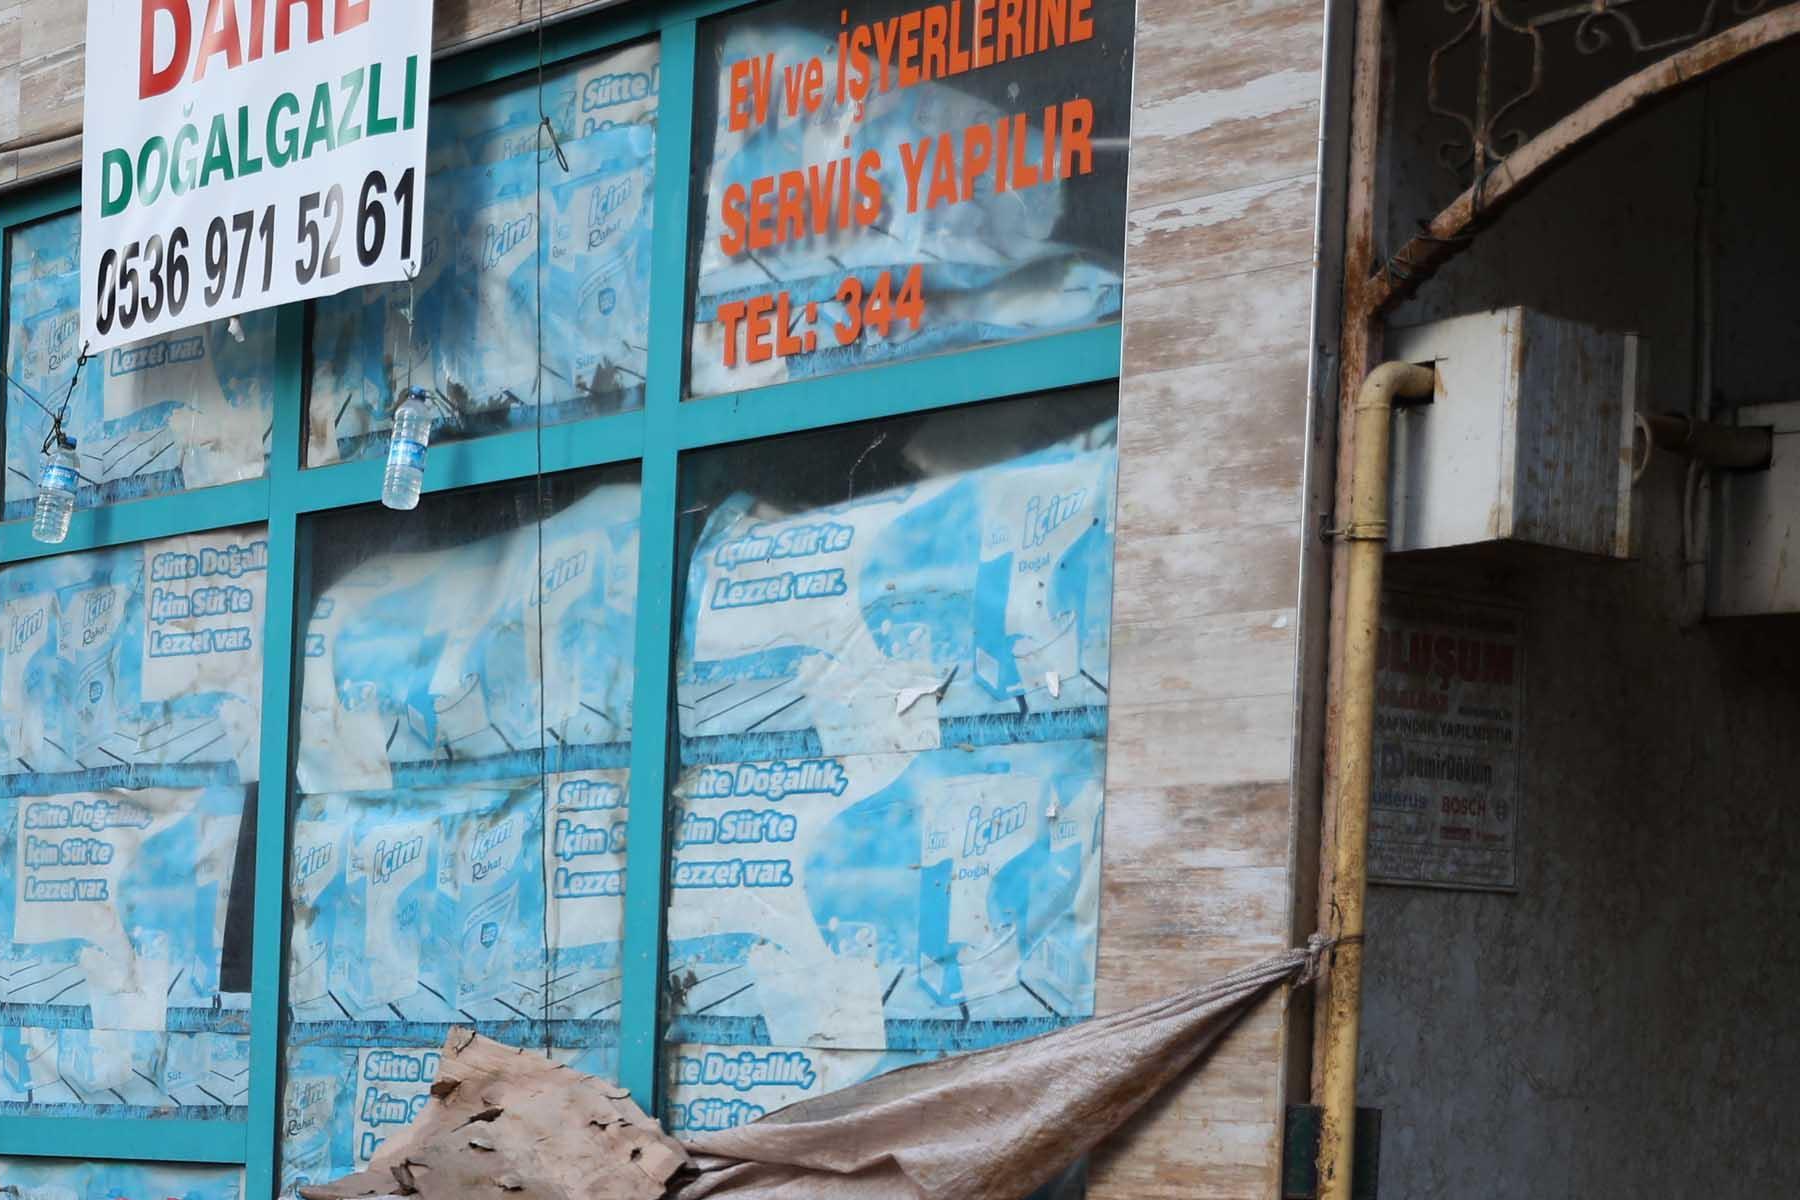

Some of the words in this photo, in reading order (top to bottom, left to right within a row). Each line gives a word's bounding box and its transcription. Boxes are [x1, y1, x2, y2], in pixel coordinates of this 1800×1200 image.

[100, 54, 417, 218] DOĞALGAZLI
[727, 53, 775, 132] EV
[784, 64, 824, 114] ve
[718, 134, 883, 256] SERVİS
[900, 98, 1094, 213] YAPILIR
[96, 226, 190, 336] 0536
[203, 204, 276, 308] 971
[295, 183, 345, 286] 52
[356, 167, 416, 268] 61
[716, 292, 817, 368] TEL:
[833, 264, 925, 345] 344
[711, 572, 795, 610] Lezzet
[795, 568, 848, 598] var.
[554, 867, 626, 898] Lezze
[672, 860, 743, 889] ezzet
[743, 858, 794, 888] var.
